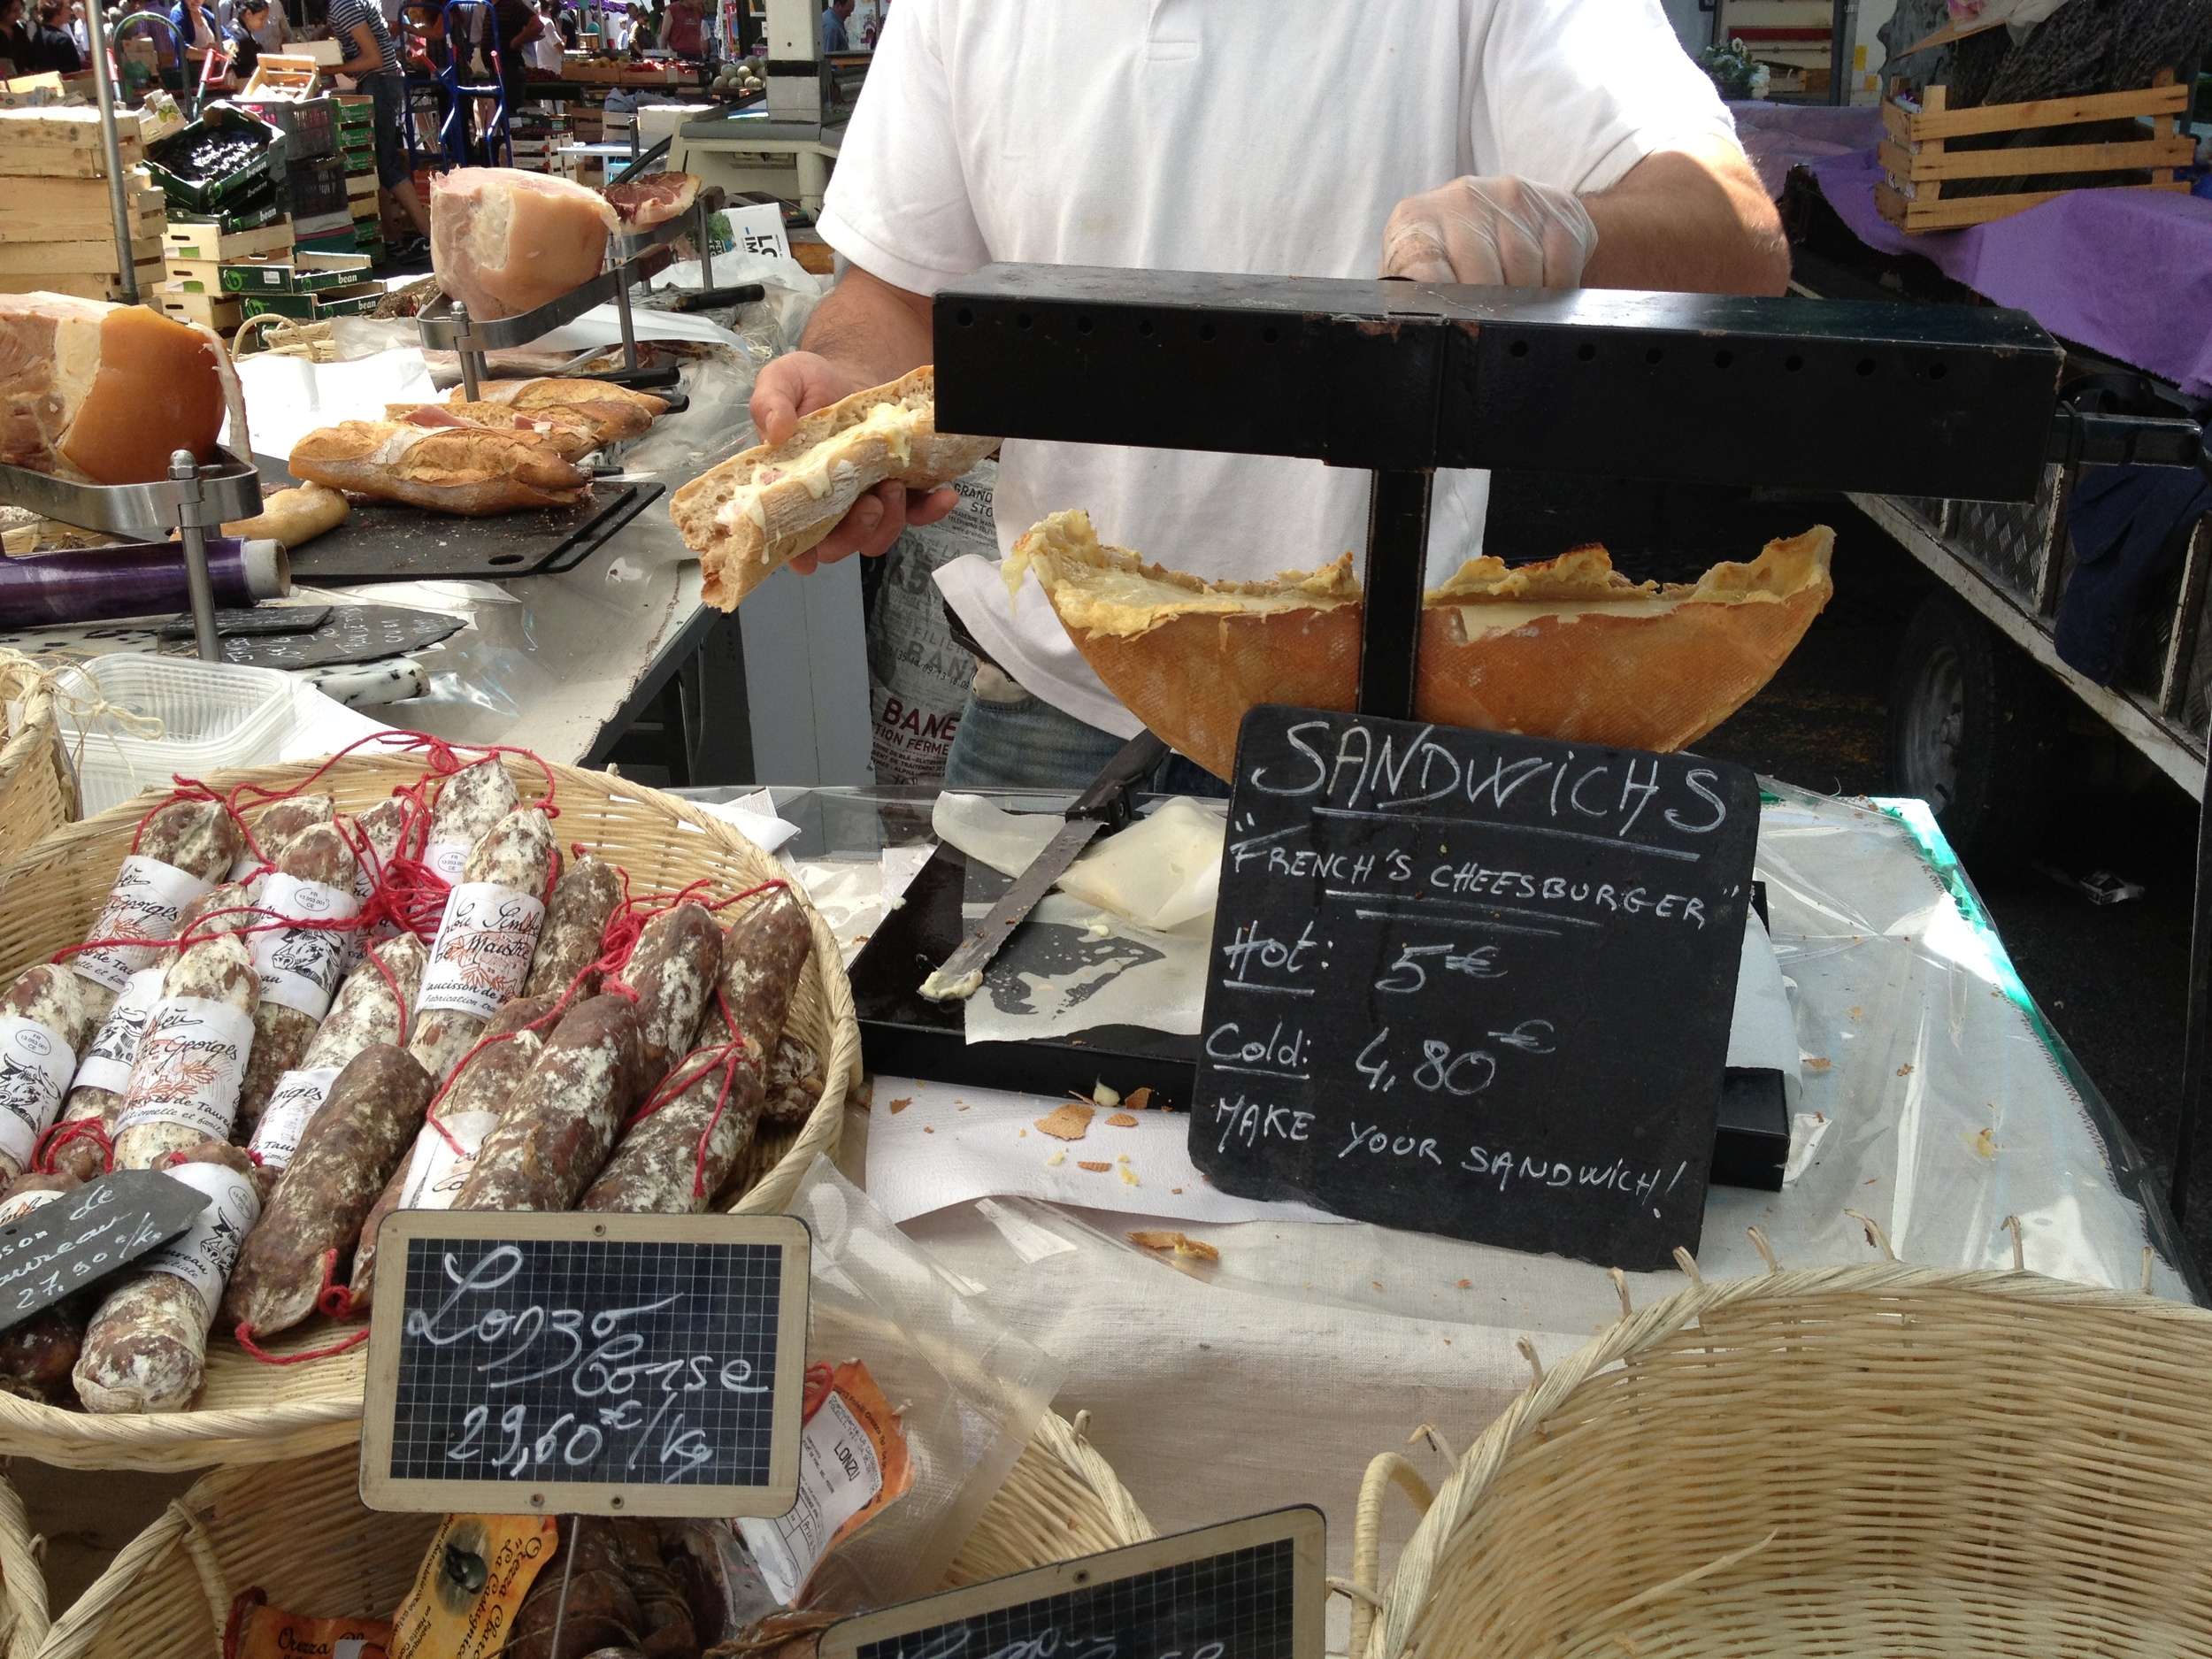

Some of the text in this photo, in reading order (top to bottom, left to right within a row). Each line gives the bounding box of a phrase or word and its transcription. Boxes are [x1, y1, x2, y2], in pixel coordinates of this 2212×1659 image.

[247, 161, 266, 178] bean
[260, 207, 277, 221] bean
[338, 273, 357, 284] bean
[358, 299, 376, 310] bean
[971, 502, 993, 518] STO
[1251, 721, 1727, 837] SANDWICHS
[1223, 920, 1334, 982] Hot:
[425, 994, 478, 1007] Fabrication
[154, 1035, 237, 1074] Georges
[1205, 1020, 1311, 1065] Cold:
[175, 1095, 194, 1108] de
[1216, 1095, 1316, 1153] MAKE
[1338, 1121, 1442, 1165] YOUR
[572, 1333, 769, 1397] Corse
[833, 1439, 861, 1482] LONZU
[499, 1536, 542, 1600] Orezza
[277, 1626, 330, 1655] Orezza
